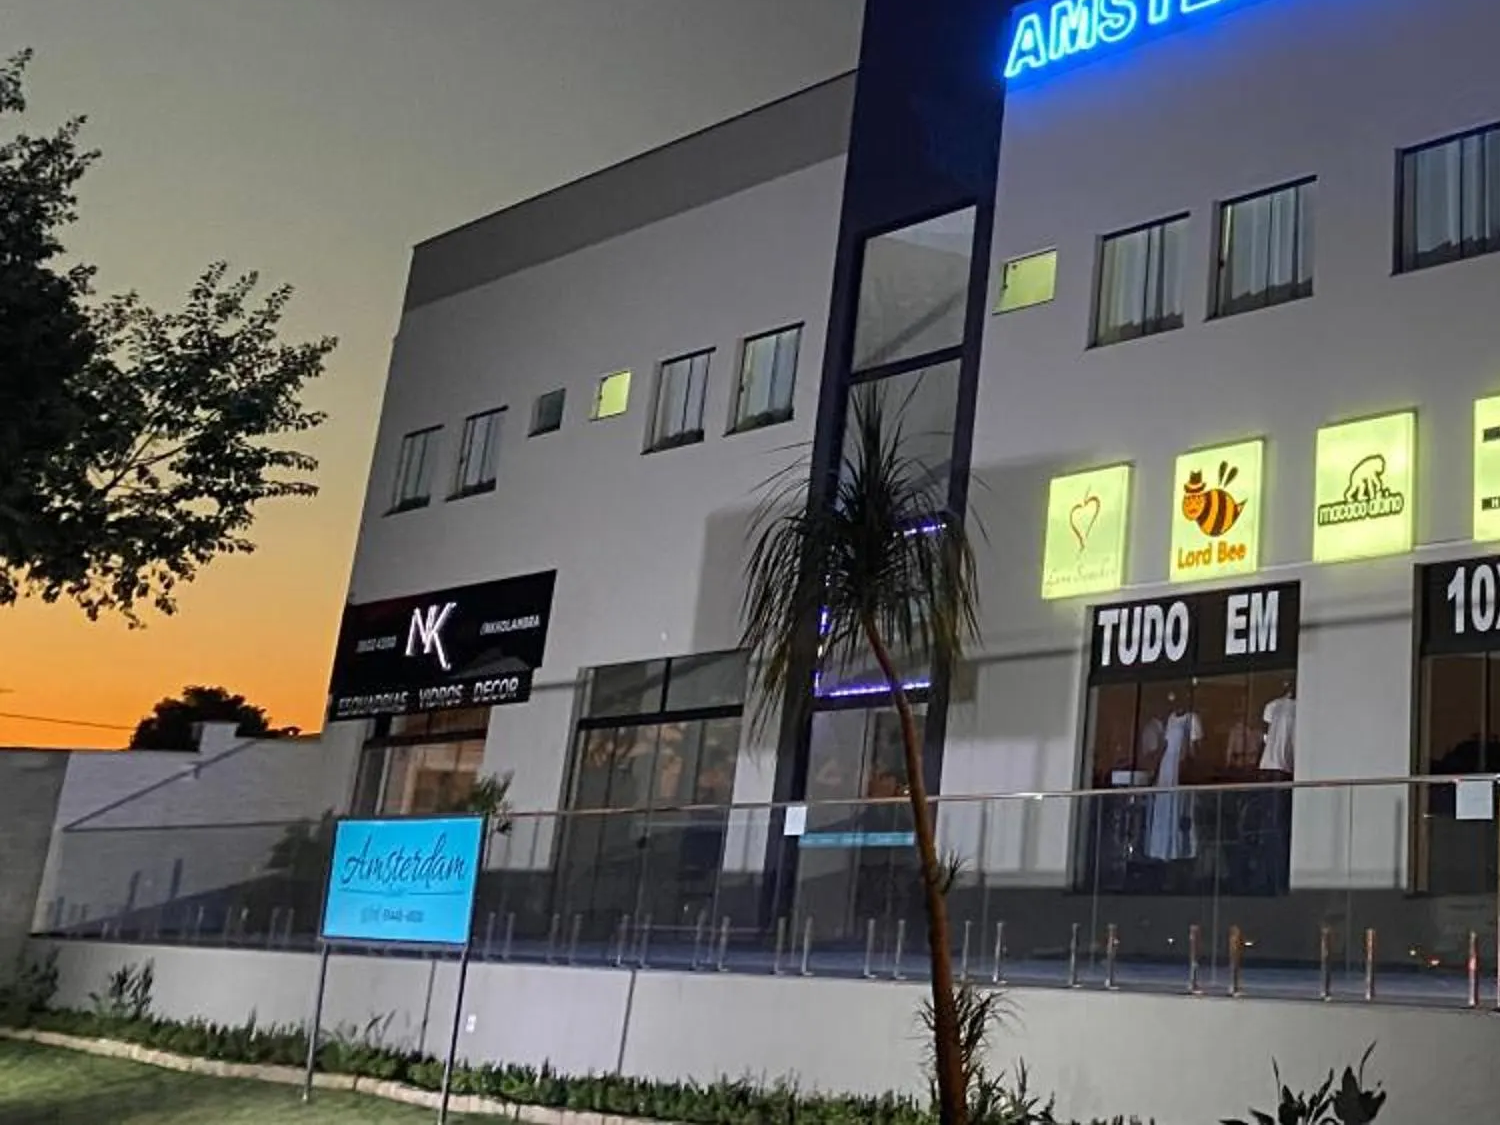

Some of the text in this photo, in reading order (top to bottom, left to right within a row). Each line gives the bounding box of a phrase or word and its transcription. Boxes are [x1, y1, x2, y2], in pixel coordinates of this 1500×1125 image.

[1177, 540, 1247, 570] Lord Bee
[1097, 590, 1280, 667] TUDO EM
[472, 676, 519, 703] DECOR
[340, 831, 465, 888] Amsterdam
